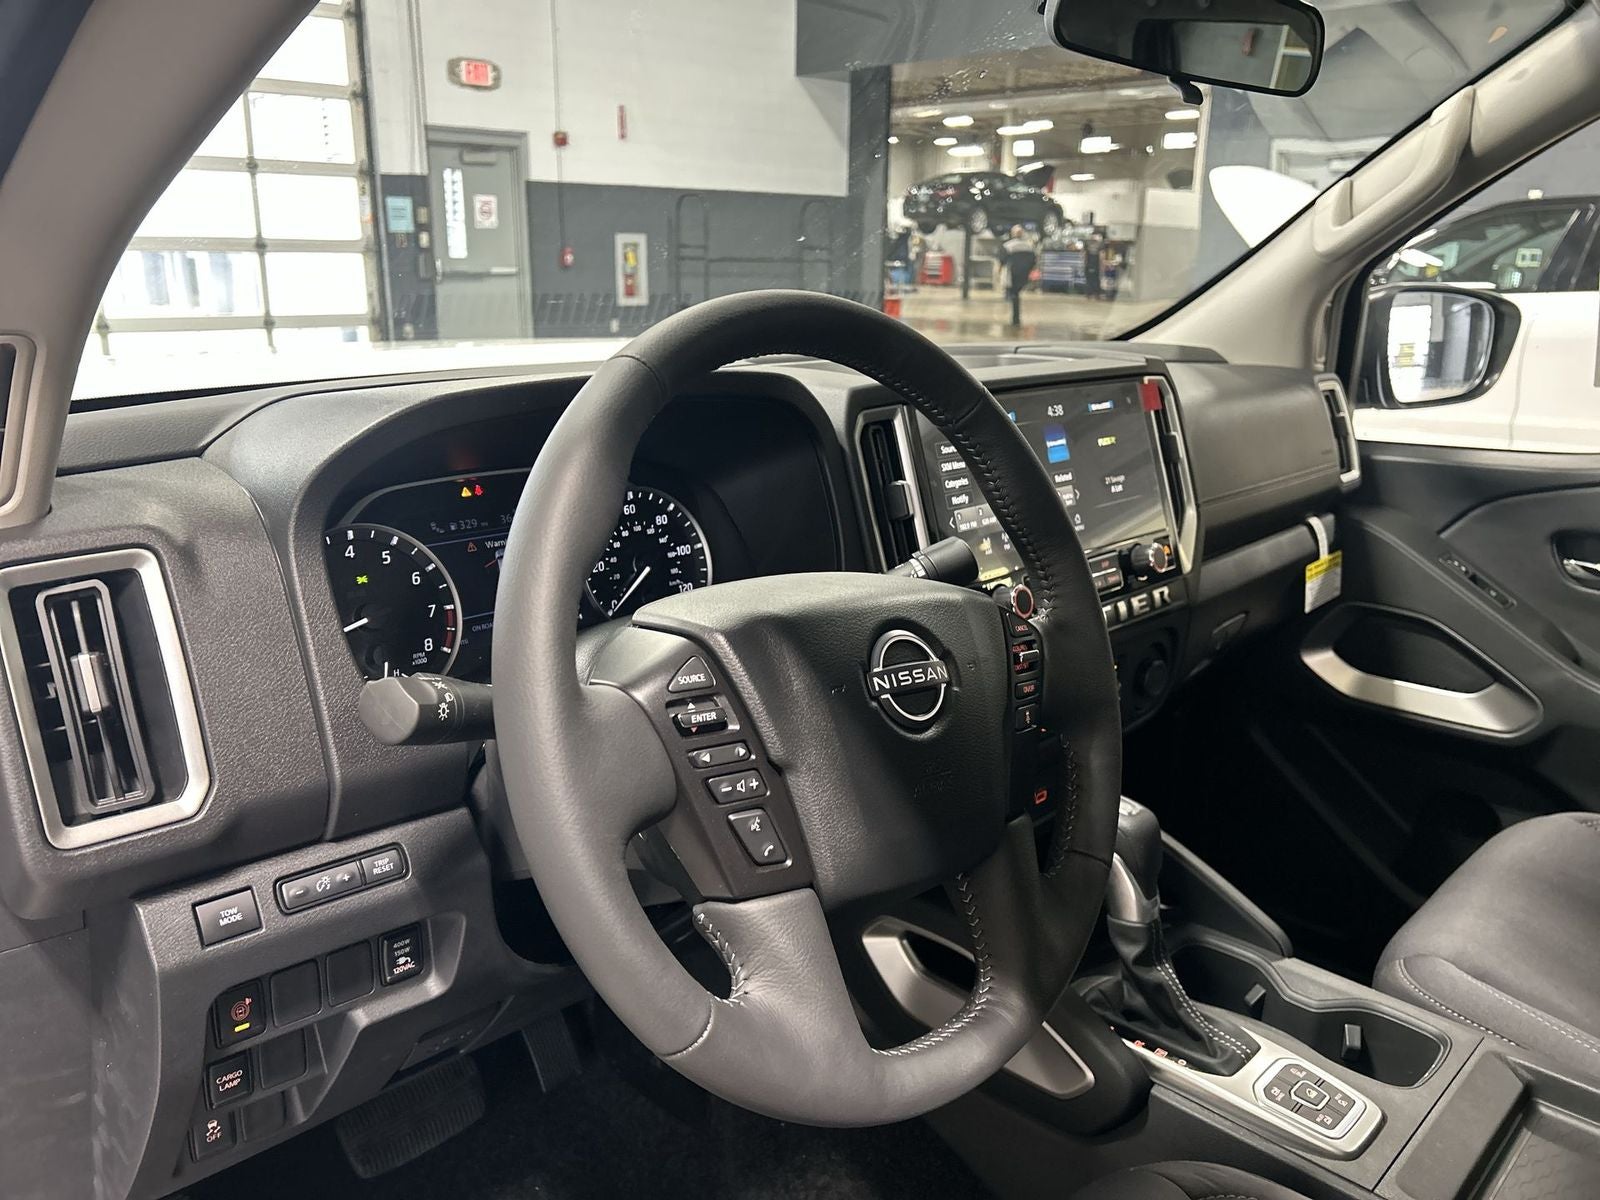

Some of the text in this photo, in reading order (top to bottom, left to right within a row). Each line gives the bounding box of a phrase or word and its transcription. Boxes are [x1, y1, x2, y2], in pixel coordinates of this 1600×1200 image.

[1047, 404, 1064, 416] 4:38
[623, 503, 636, 515] 60
[459, 518, 478, 530] 329
[655, 514, 668, 526] 80
[344, 544, 355, 559] 4
[676, 544, 692, 556] 100
[381, 550, 391, 564] 5
[592, 560, 605, 573] 20
[411, 571, 421, 585] 6
[679, 582, 693, 593] 120
[427, 604, 437, 618] 7
[424, 637, 433, 651] 8
[412, 651, 426, 659] RPM
[412, 657, 428, 666] x1000
[677, 673, 706, 685] SOURCE
[872, 665, 948, 691] NISSAN
[691, 711, 717, 723] ENTER
[373, 858, 390, 868] TRIP
[372, 863, 394, 876] RESET
[219, 906, 238, 918] TOW
[219, 912, 243, 926] MODE
[393, 960, 416, 974] 120VAC
[216, 1069, 243, 1085] CARGO
[219, 1079, 241, 1092] LAMP
[206, 1131, 221, 1143] OFF
